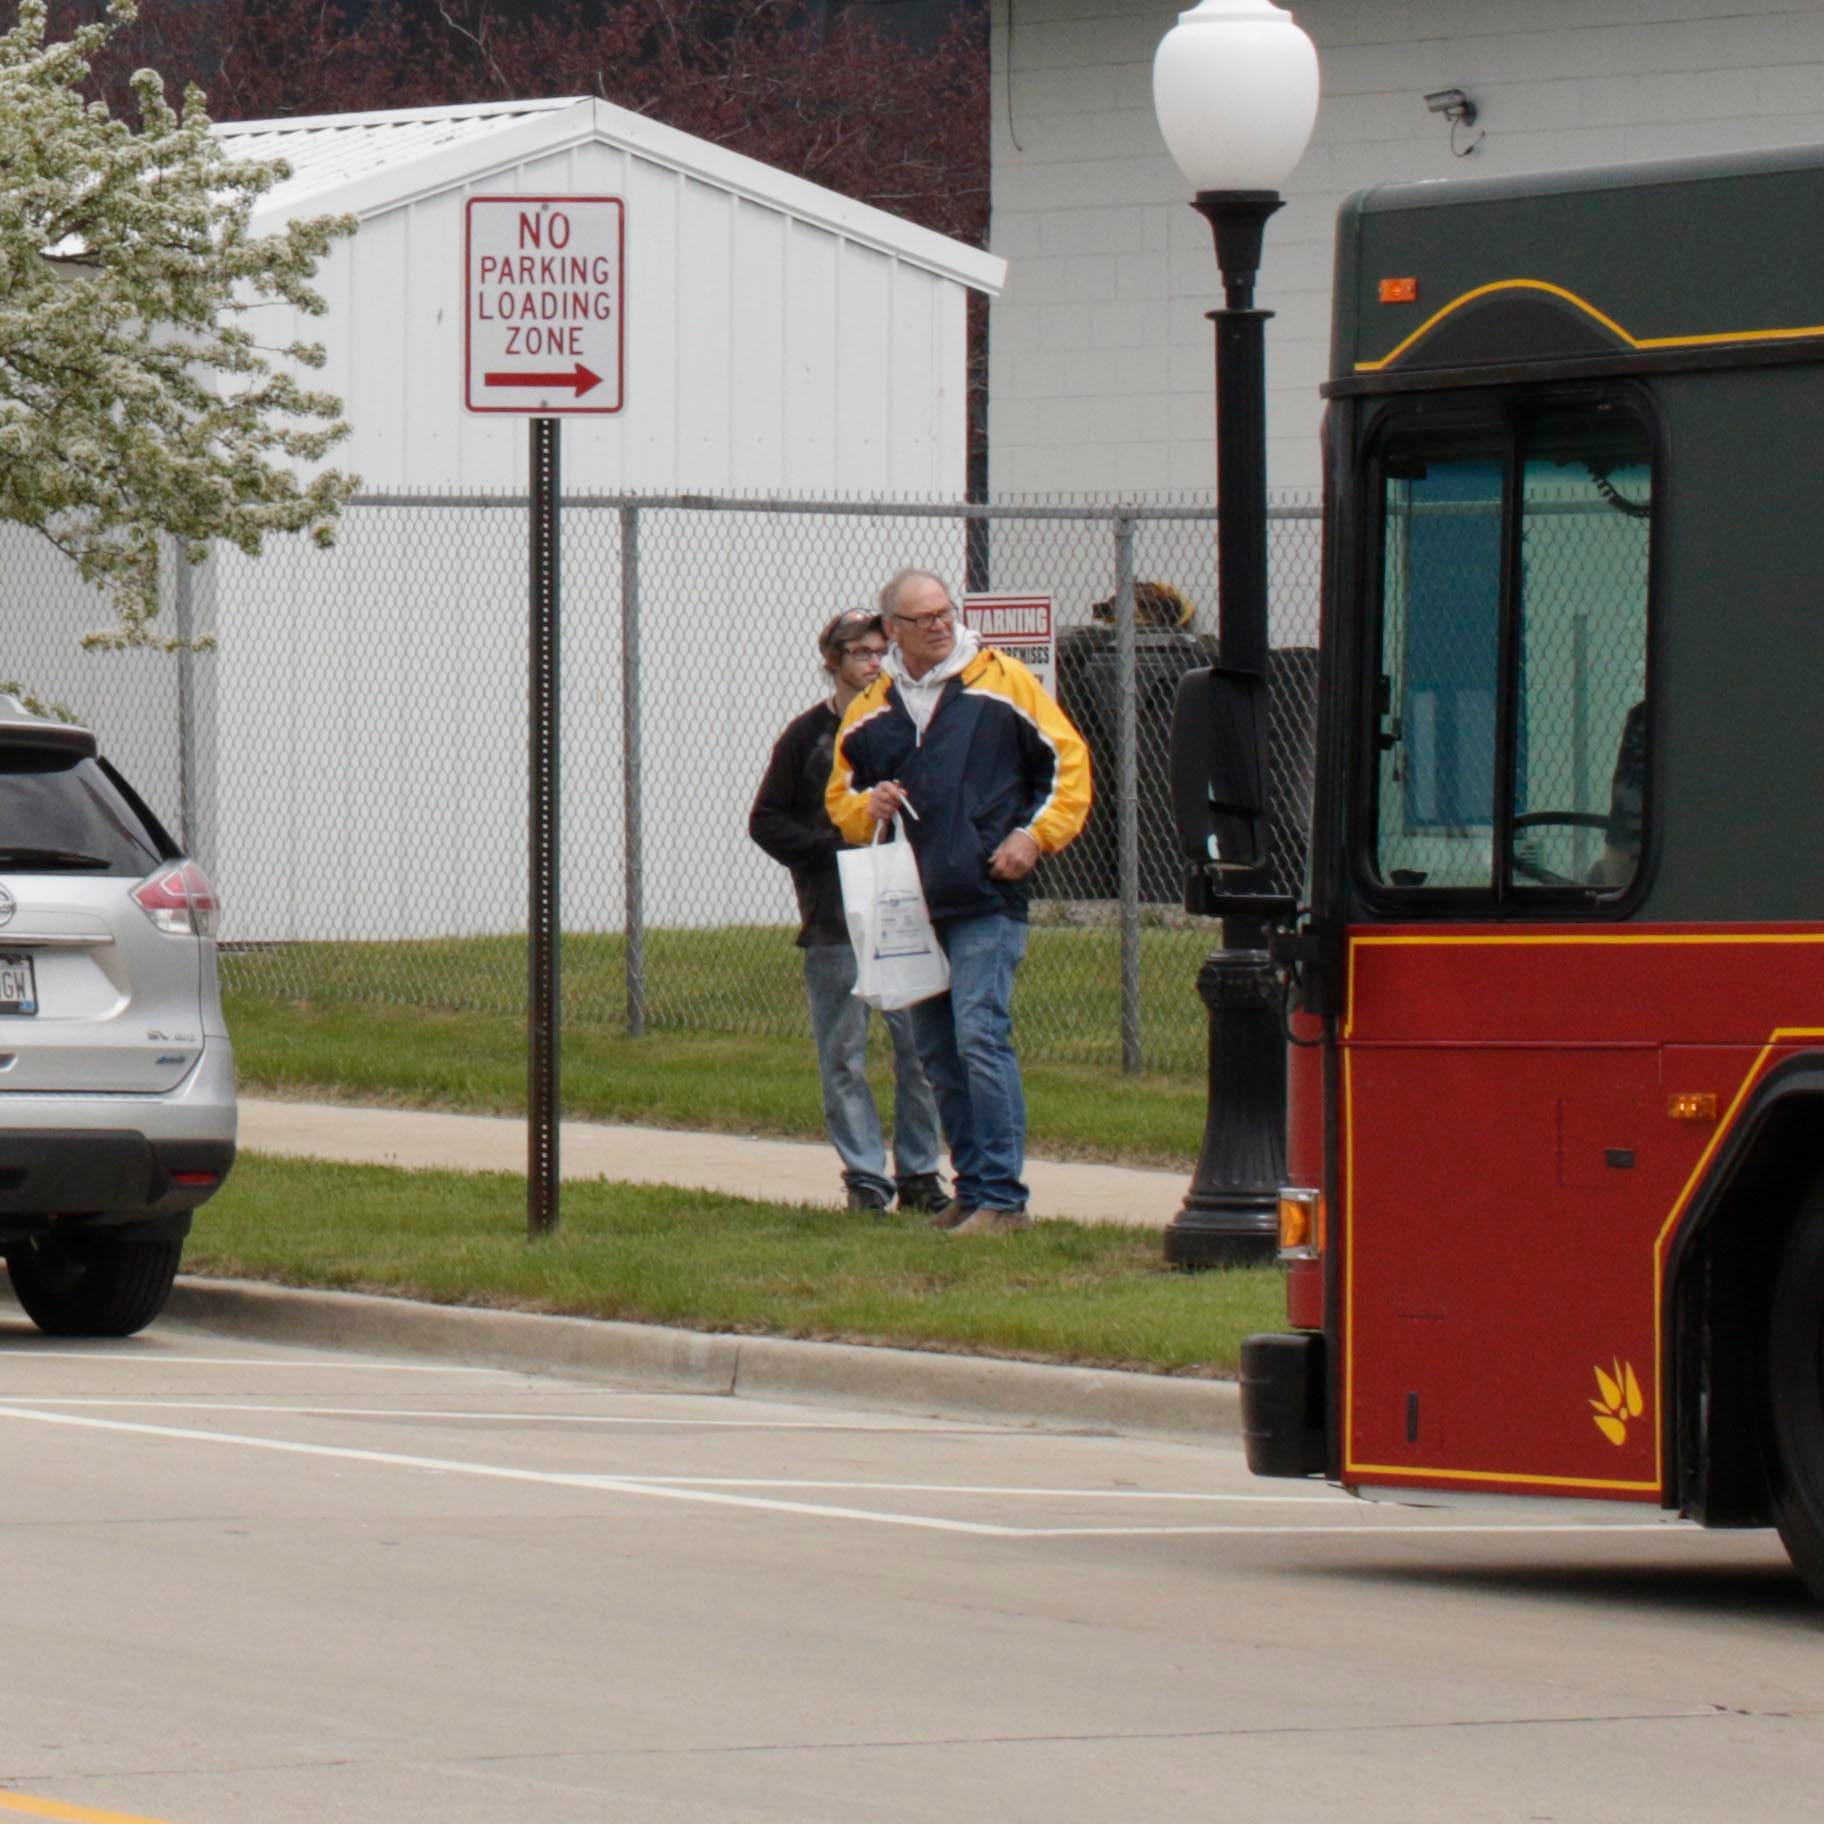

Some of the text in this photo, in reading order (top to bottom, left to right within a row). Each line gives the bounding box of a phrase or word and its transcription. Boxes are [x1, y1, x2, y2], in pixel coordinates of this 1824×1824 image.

[520, 212, 570, 249] NO
[480, 256, 609, 285] PARKING
[479, 291, 610, 320] LOADING
[505, 327, 584, 355] ZONE
[966, 606, 1048, 634] WARNING
